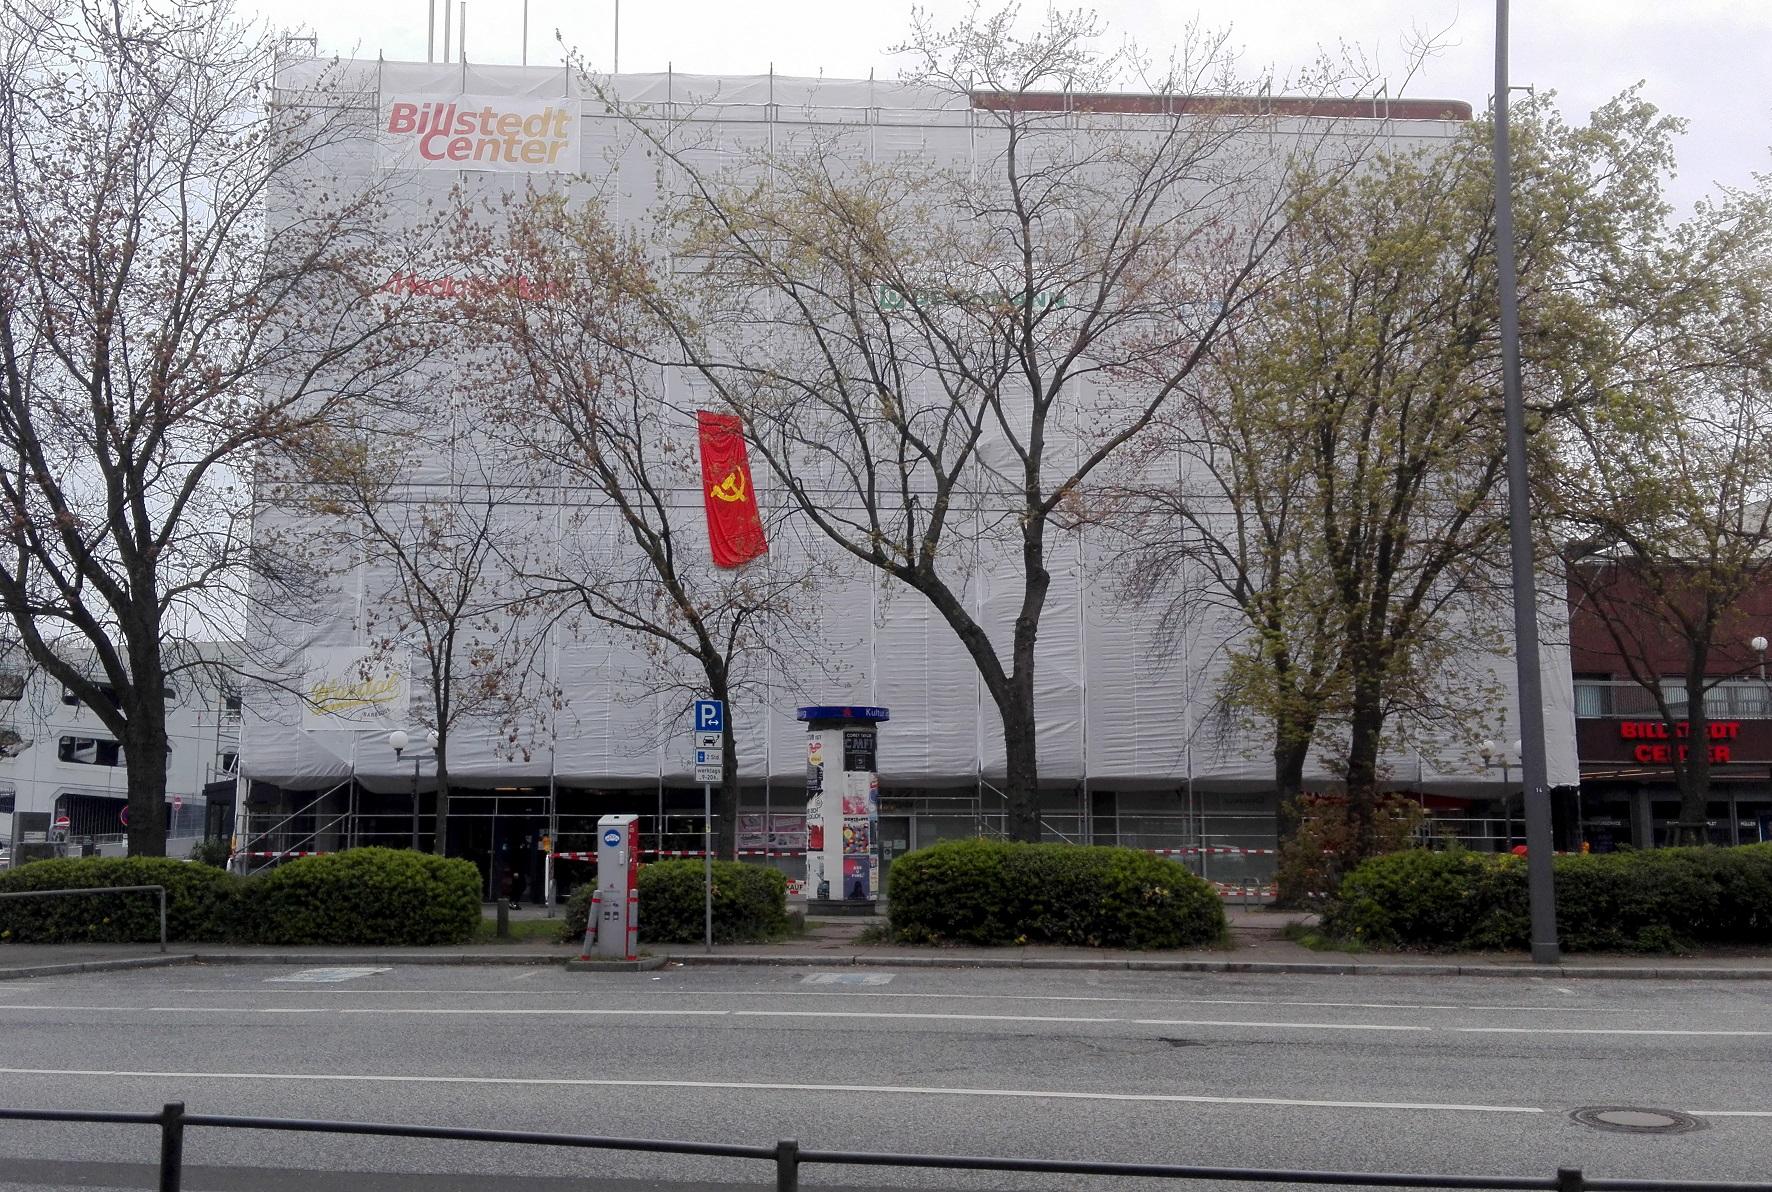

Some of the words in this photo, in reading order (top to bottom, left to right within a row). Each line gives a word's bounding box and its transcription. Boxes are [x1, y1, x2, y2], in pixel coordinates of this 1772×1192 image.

[387, 102, 572, 138] Billstedt
[419, 131, 569, 164] Center
[702, 704, 716, 727] P
